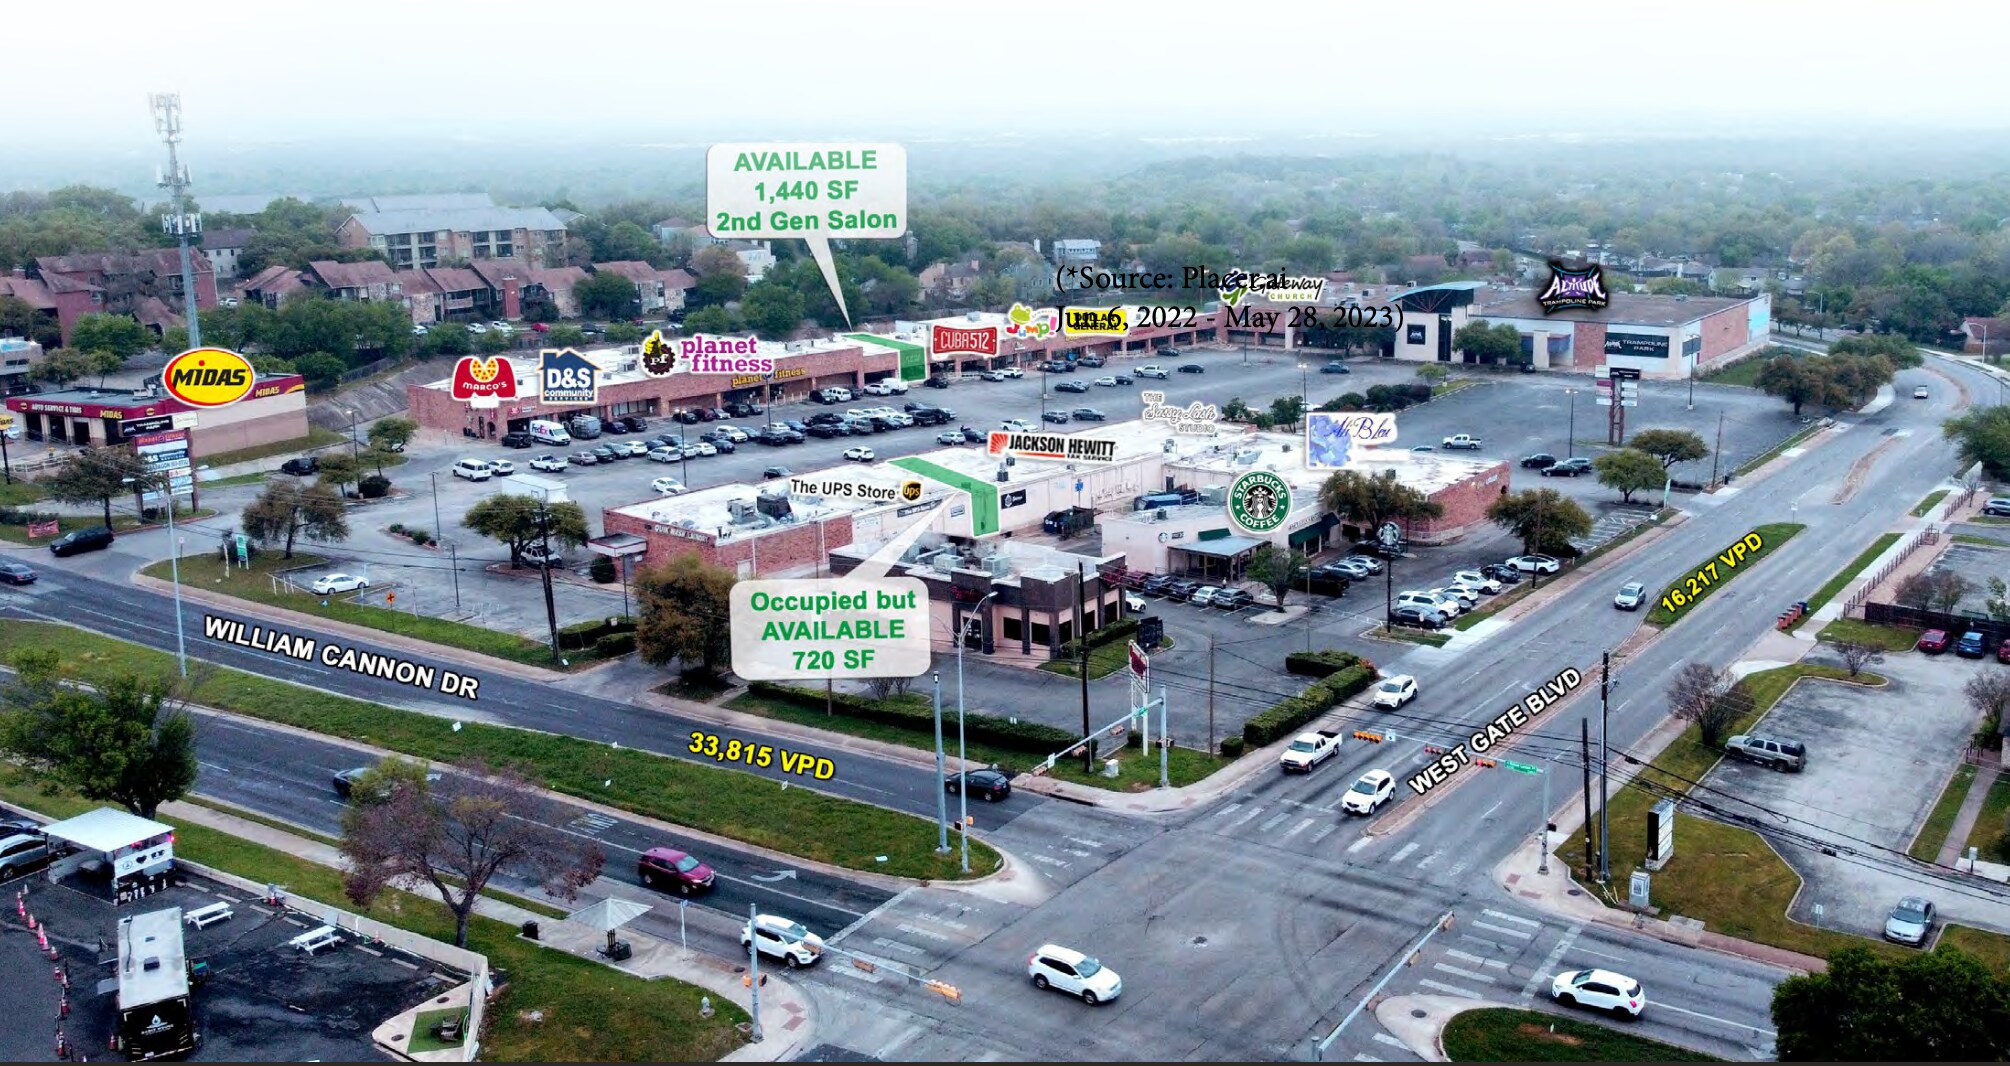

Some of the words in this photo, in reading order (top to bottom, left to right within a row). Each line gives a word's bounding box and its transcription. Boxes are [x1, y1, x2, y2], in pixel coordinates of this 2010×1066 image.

[1622, 339, 1668, 348] TRAMPOLINE
[732, 375, 763, 388] planet
[774, 367, 806, 380] fitness
[255, 386, 281, 398] MIDAS
[99, 409, 123, 420] MIDAS
[531, 422, 548, 435] FedEx
